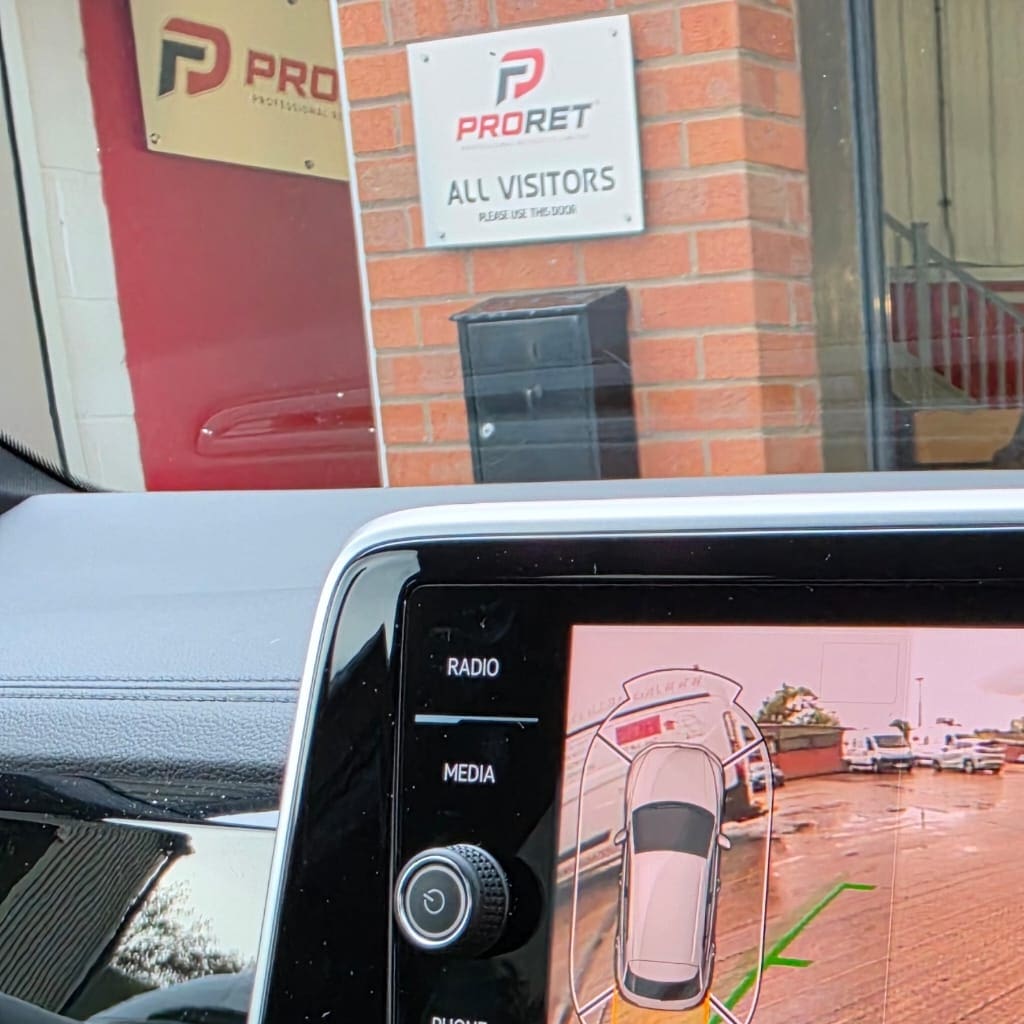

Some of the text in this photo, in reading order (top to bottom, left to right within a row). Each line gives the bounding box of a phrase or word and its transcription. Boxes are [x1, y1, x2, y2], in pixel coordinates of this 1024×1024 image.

[456, 102, 592, 141] PRORET
[448, 166, 615, 205] ALL VISITORS
[479, 209, 509, 222] PLEASE
[511, 208, 528, 219] USE
[530, 206, 551, 218] THIS
[447, 657, 500, 678] RADIO
[443, 762, 496, 784] MEDIA
